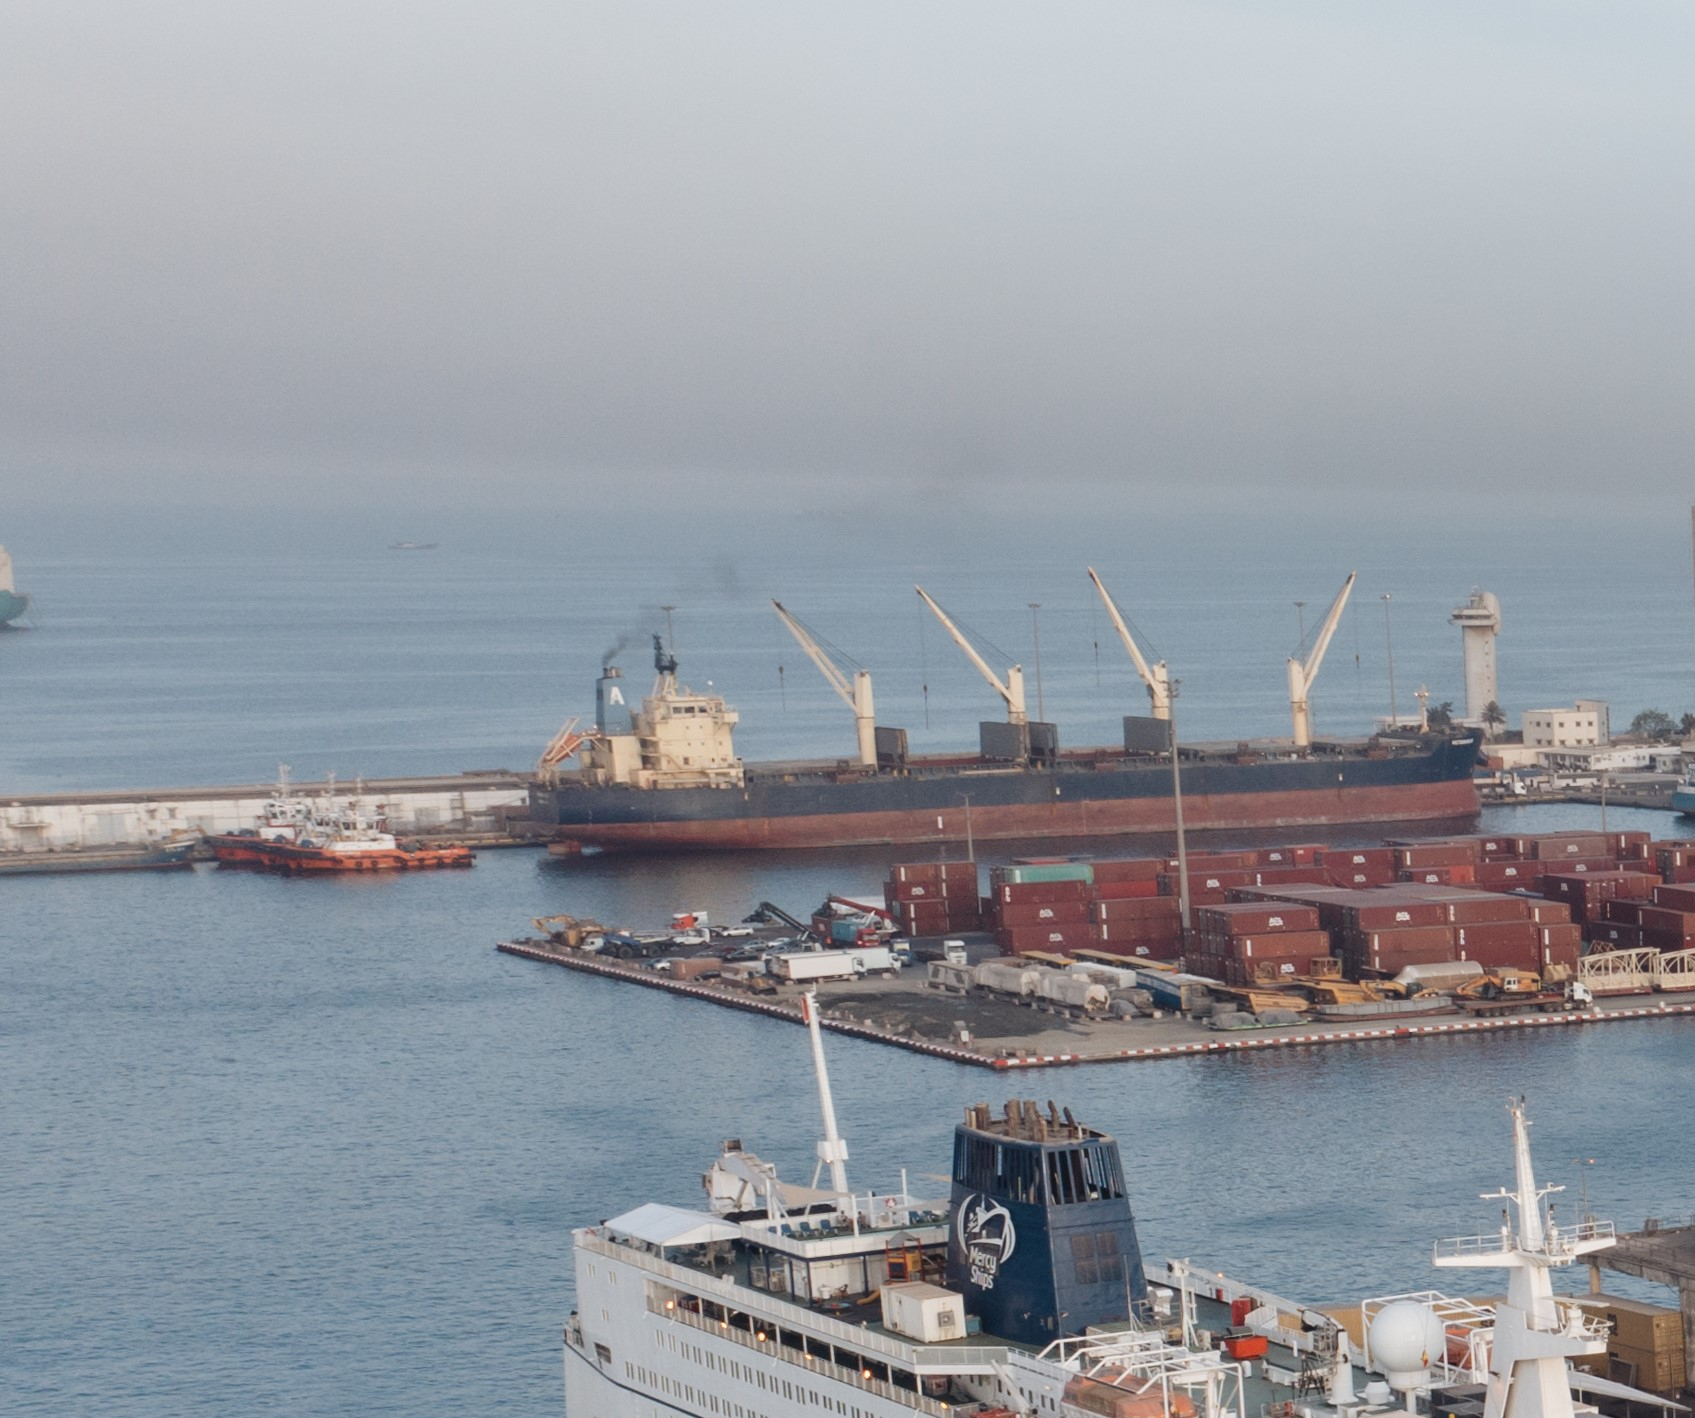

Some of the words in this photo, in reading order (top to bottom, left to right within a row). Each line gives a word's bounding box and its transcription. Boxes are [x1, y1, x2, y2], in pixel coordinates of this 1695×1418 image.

[609, 686, 625, 705] A
[969, 1245, 997, 1274] Mercy
[970, 1265, 995, 1291] Ships
